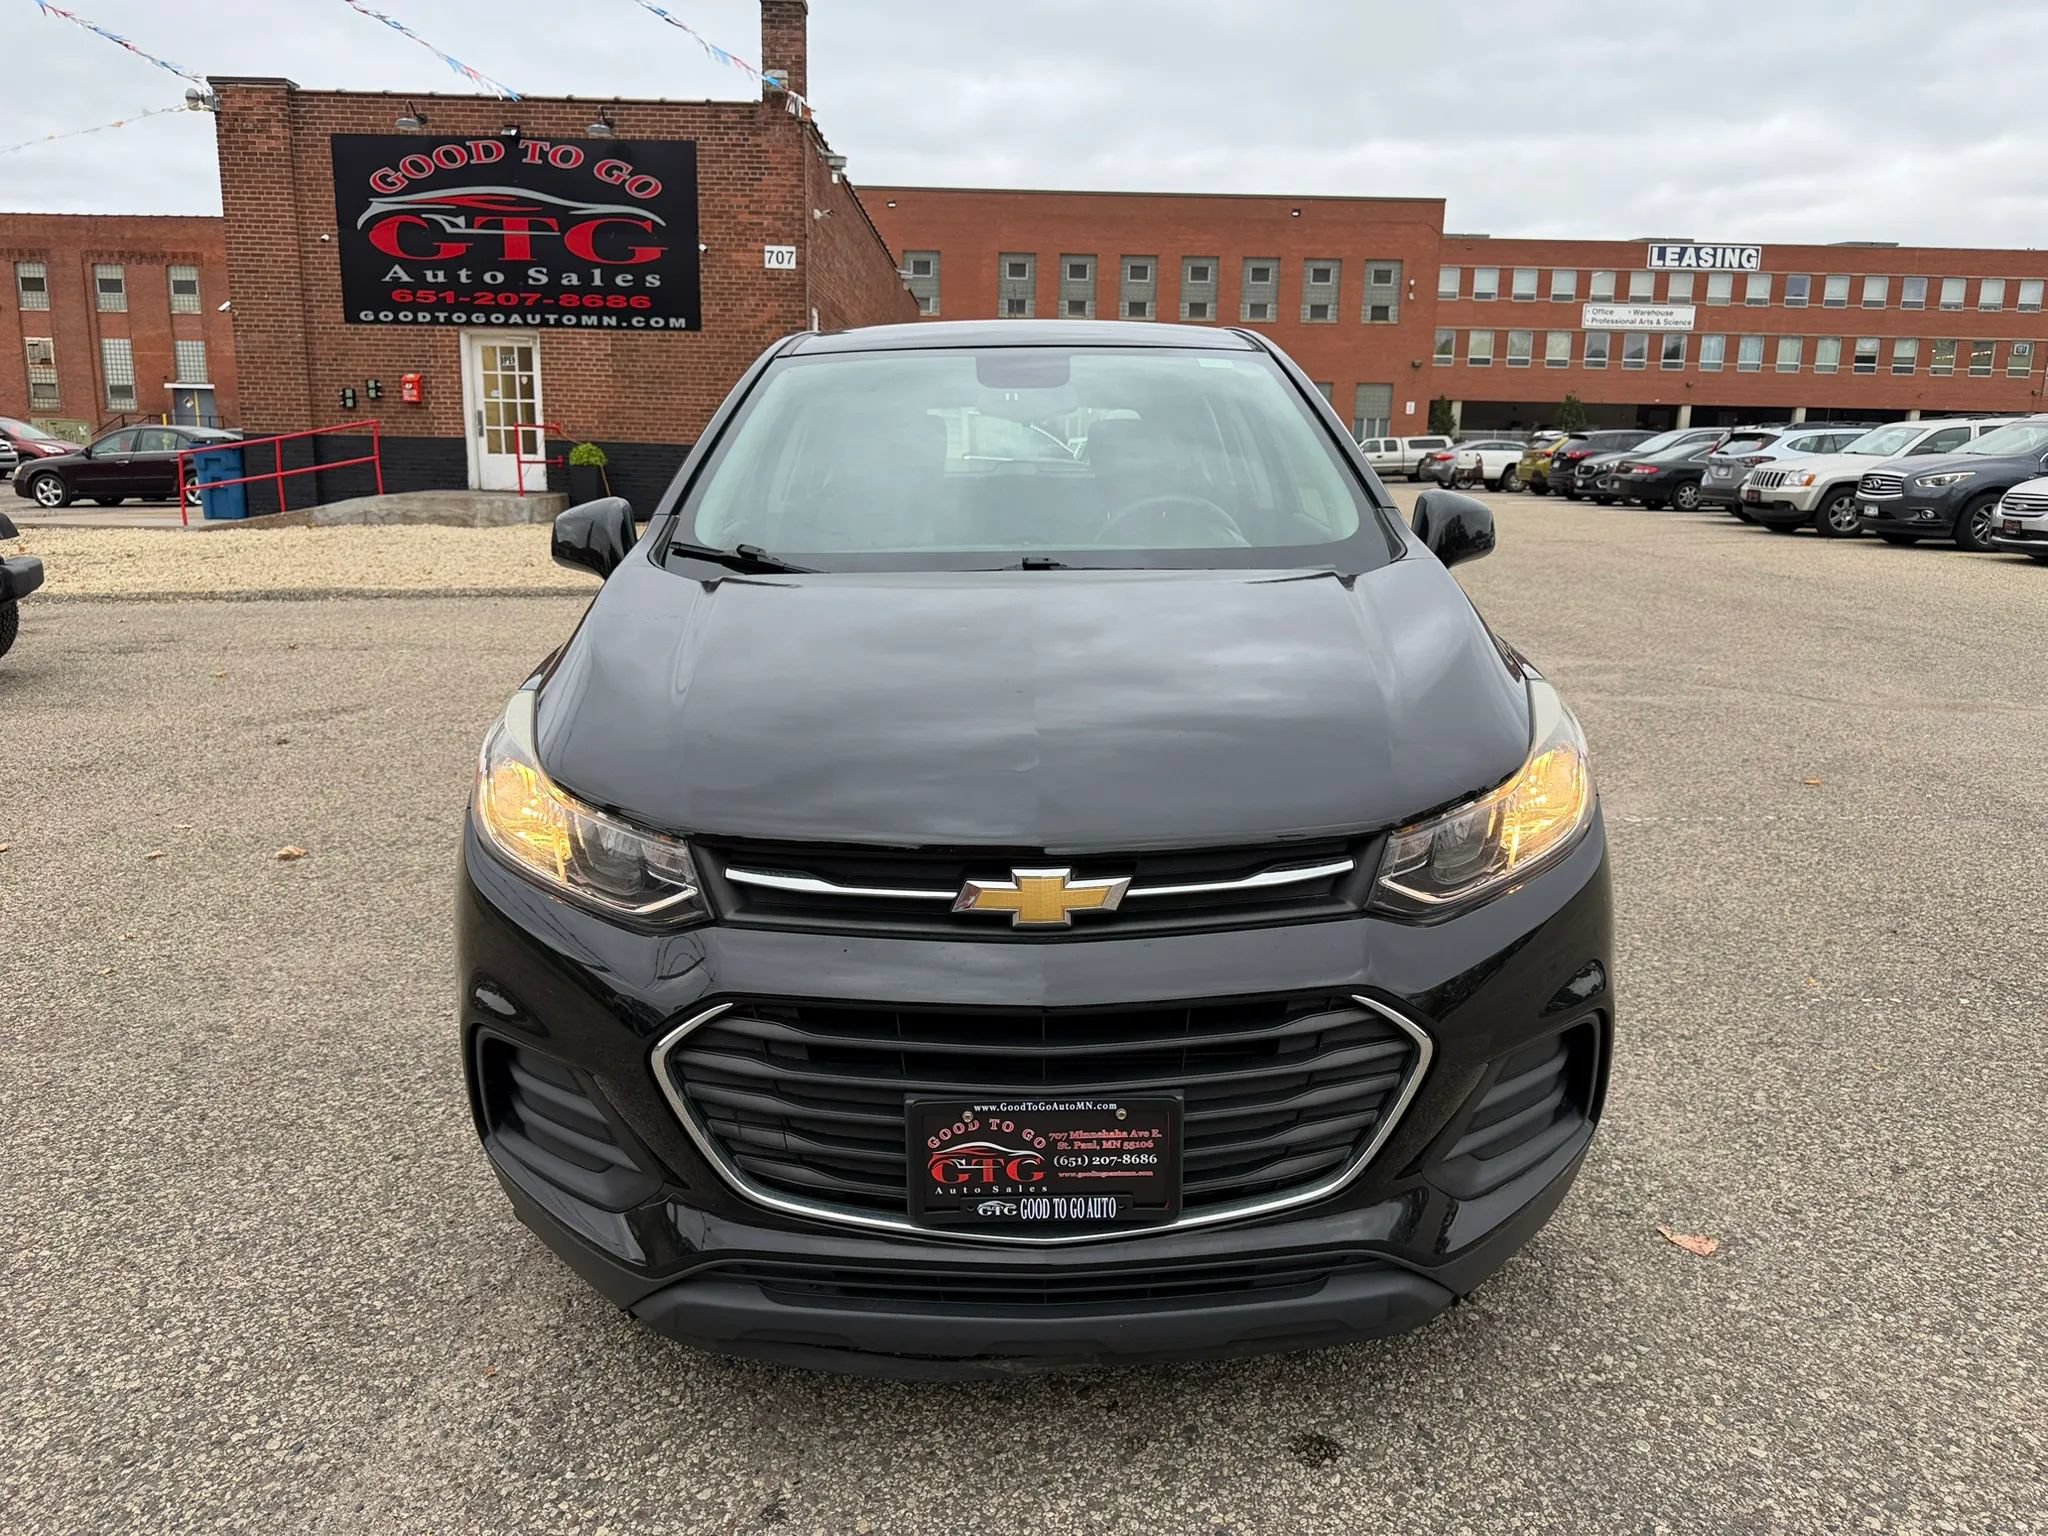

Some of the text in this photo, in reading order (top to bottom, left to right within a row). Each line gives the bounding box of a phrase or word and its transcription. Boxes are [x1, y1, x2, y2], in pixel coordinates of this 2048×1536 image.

[369, 139, 662, 198] GOOD TO GO
[369, 215, 668, 264] GTG
[766, 251, 794, 265] 707
[1651, 247, 1758, 269] LEASING
[381, 263, 661, 288] Auto Sales
[391, 289, 651, 309] 651-207-8686
[359, 311, 686, 328] GOODTOGOAUTOMN.COM
[1591, 308, 1674, 317] Office Warehouse
[974, 1101, 1117, 1111] www.GoodToGoAutoMN.com
[927, 1118, 1046, 1149] GOOD TO GO
[1049, 1132, 1068, 1141] 707
[1129, 1129, 1150, 1138] Ave
[1151, 1129, 1162, 1138] E.
[1057, 1141, 1071, 1150] St.
[1102, 1140, 1121, 1149] MN
[1123, 1140, 1154, 1150] 55106
[1053, 1153, 1158, 1167] (651) 207-8686
[931, 1158, 1046, 1183] GTG
[935, 1185, 1047, 1195] Auto Sales
[978, 1197, 1116, 1219] GTG GOOD TO GO AUTO
